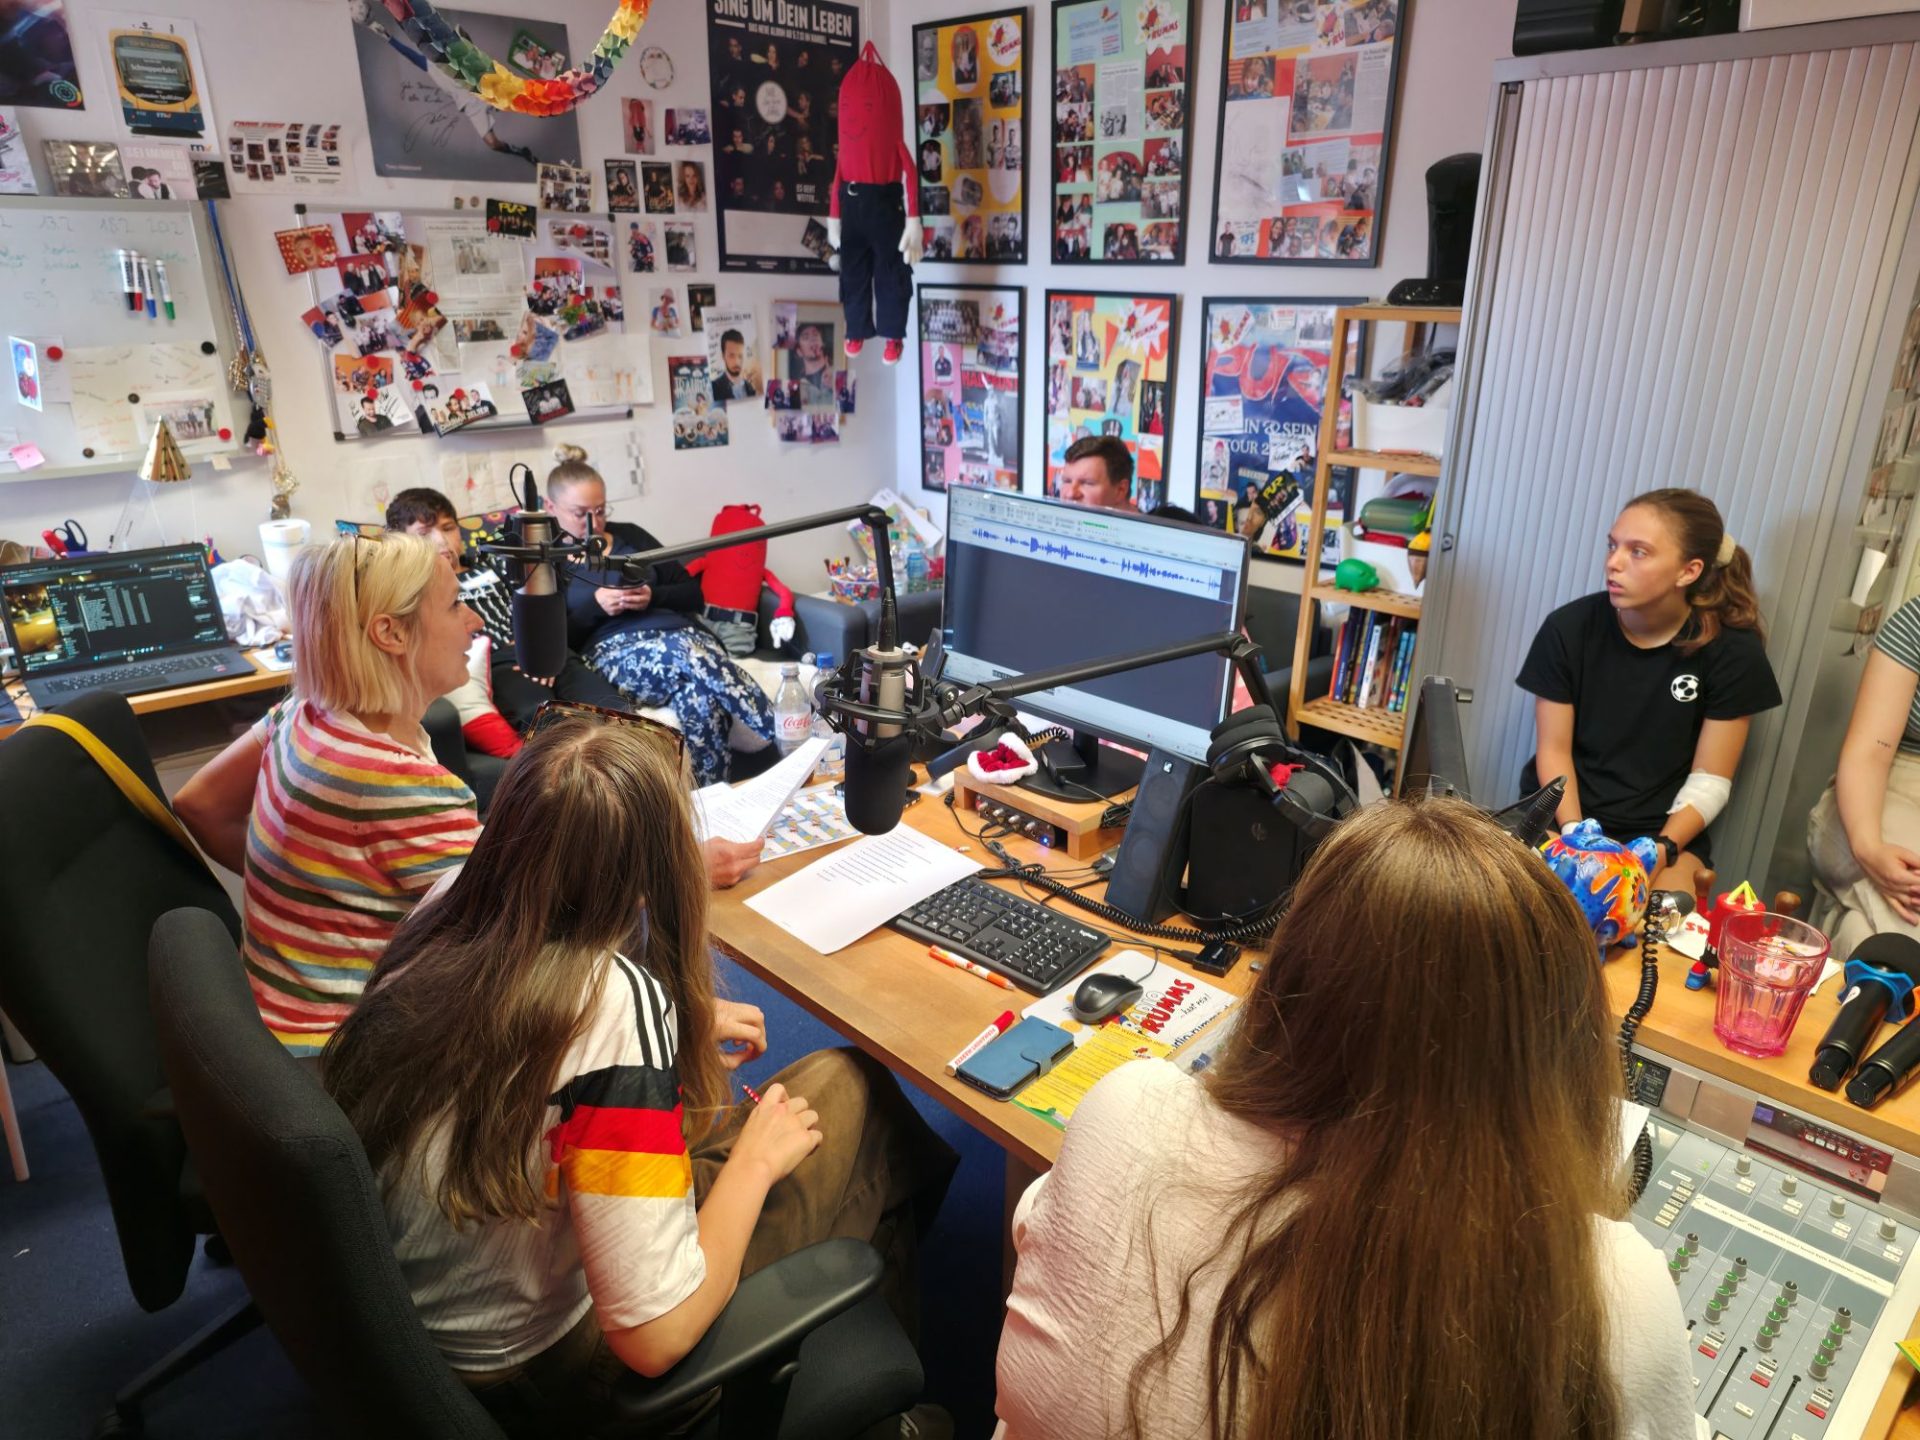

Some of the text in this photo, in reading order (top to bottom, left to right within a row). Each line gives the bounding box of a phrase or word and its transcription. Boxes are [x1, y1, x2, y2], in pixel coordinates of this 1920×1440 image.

[714, 0, 852, 37] SING UM DEIN LEBEN
[1151, 20, 1179, 40] RUMMS
[498, 202, 528, 214] PUR
[1206, 342, 1332, 415] PUR
[1244, 418, 1258, 433] IN
[1282, 421, 1317, 437] SEIN
[1262, 475, 1284, 501] PUR
[1140, 978, 1195, 1035] RUMMS
